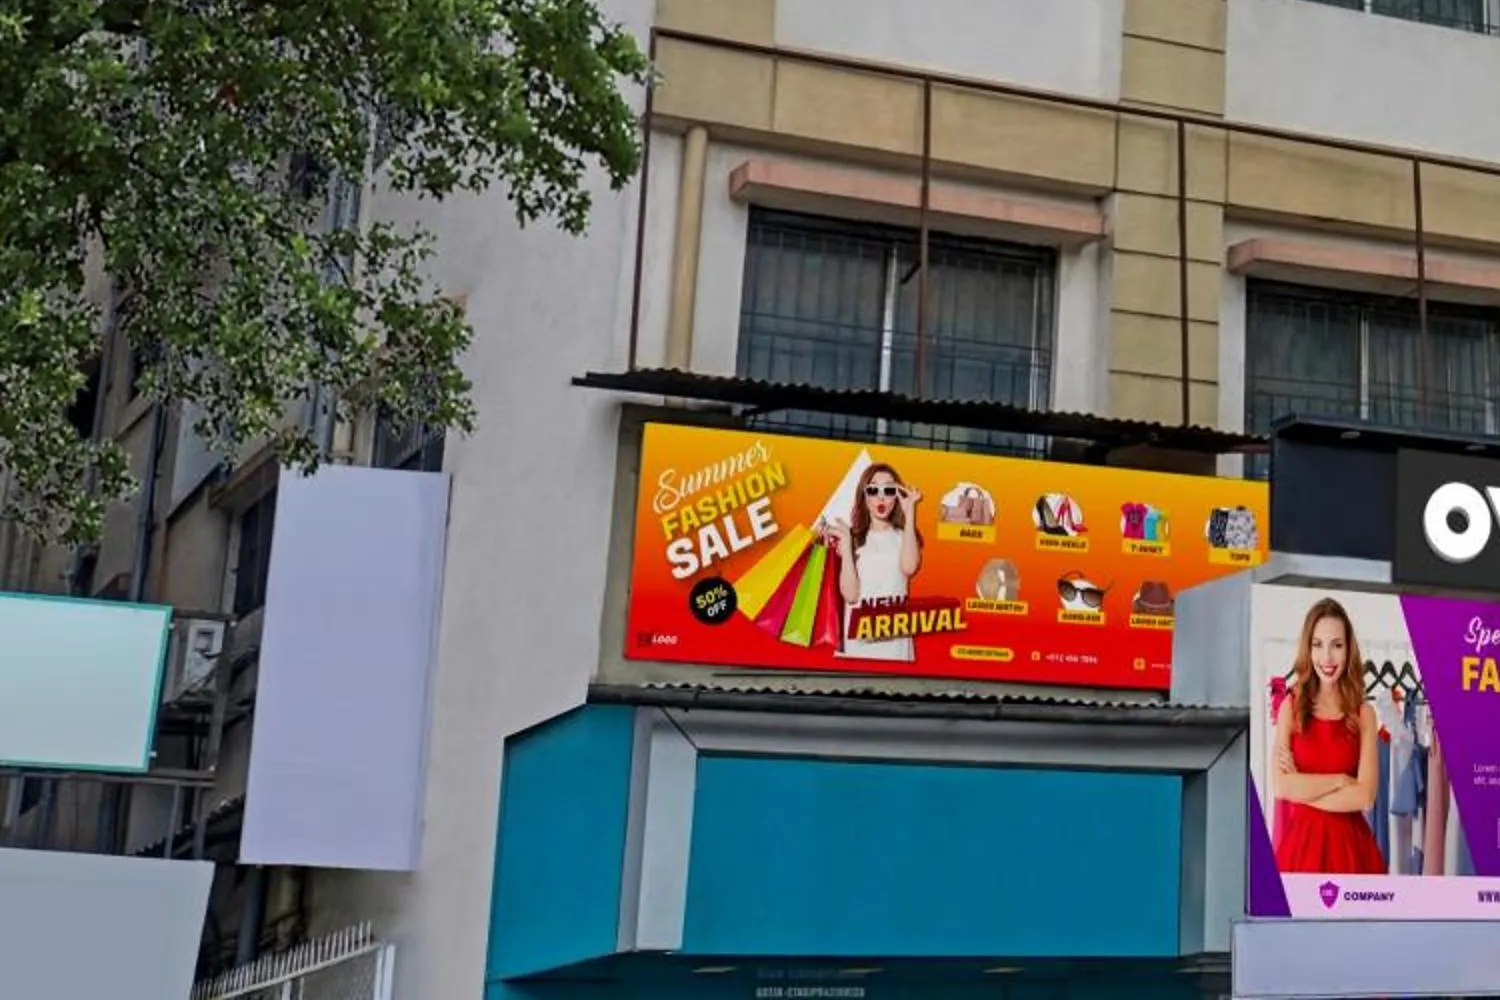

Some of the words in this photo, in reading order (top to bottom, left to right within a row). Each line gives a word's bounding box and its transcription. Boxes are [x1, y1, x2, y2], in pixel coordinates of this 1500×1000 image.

[653, 440, 771, 513] Summer
[661, 462, 786, 540] FASHION
[666, 496, 779, 579] SALE
[696, 584, 728, 609] 50%
[707, 600, 728, 617] OFF
[856, 608, 968, 639] ARRIVAL
[1343, 890, 1395, 902] COMPANY
